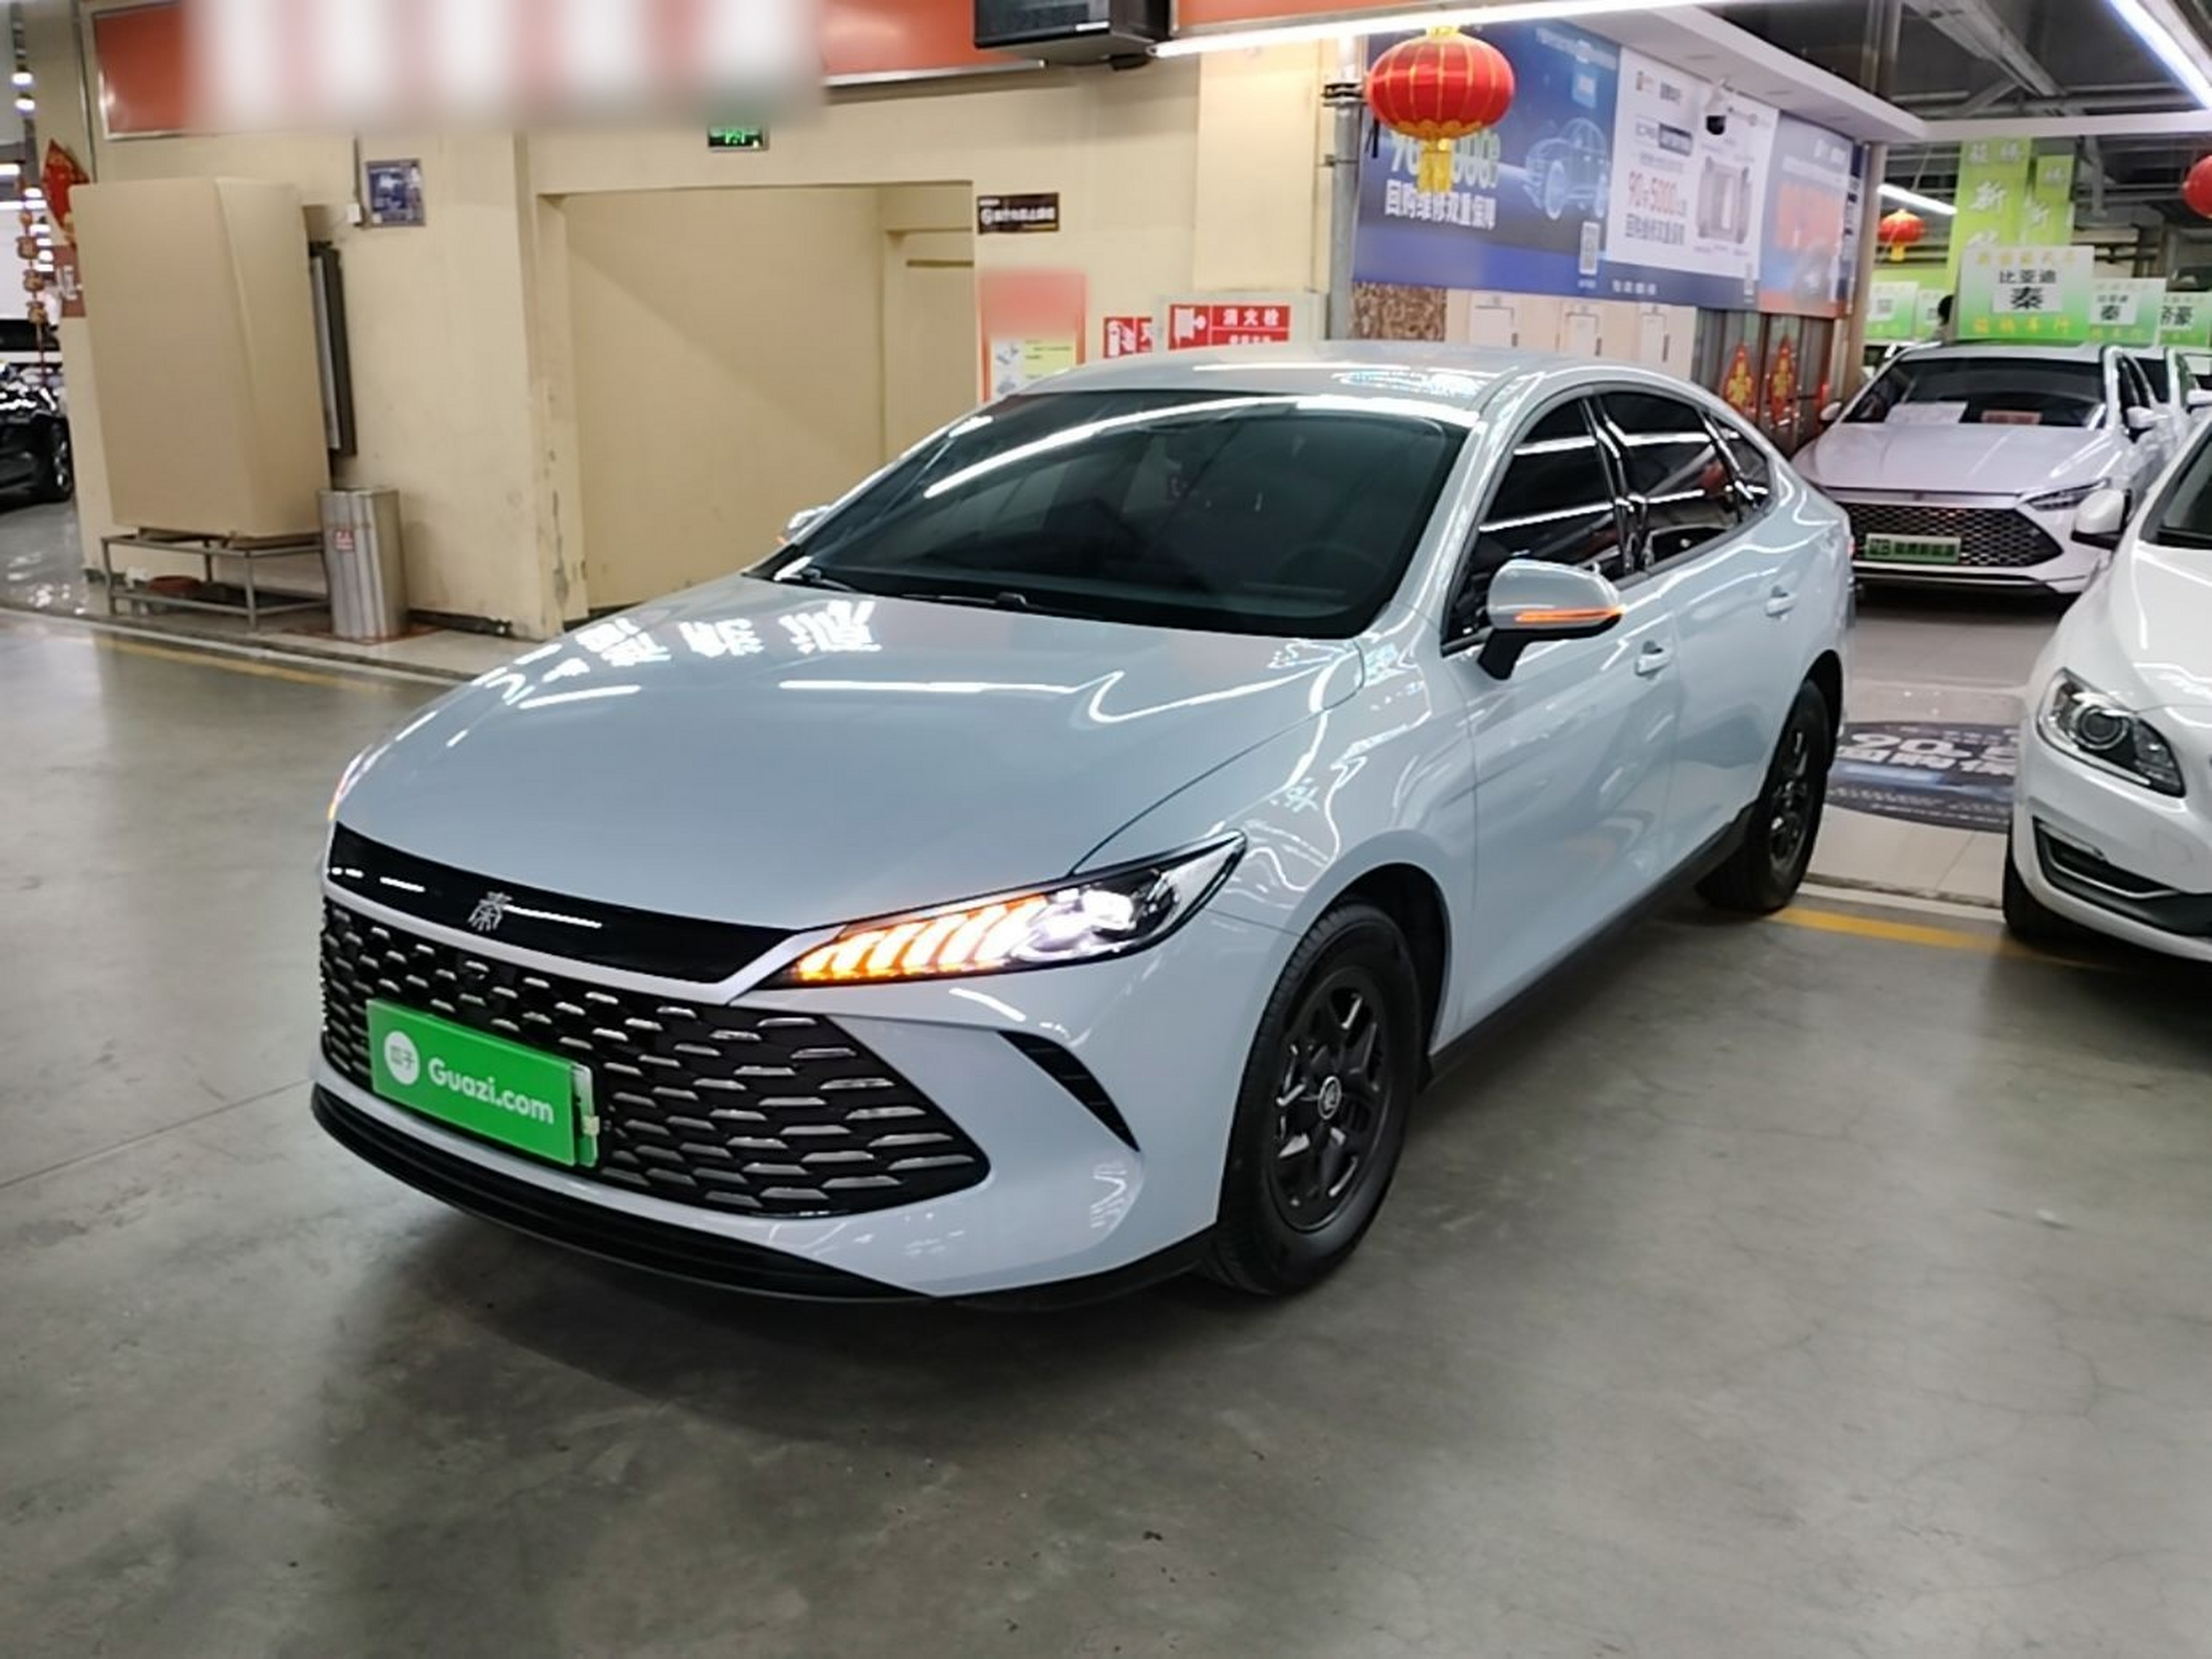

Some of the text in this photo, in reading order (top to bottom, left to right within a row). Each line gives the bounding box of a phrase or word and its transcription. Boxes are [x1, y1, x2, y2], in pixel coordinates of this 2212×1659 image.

[1999, 270, 2056, 284] 比亚迪
[2009, 286, 2044, 310] 秦
[1223, 308, 1280, 327] 消火栓
[427, 1056, 555, 1125] Guazi.com
